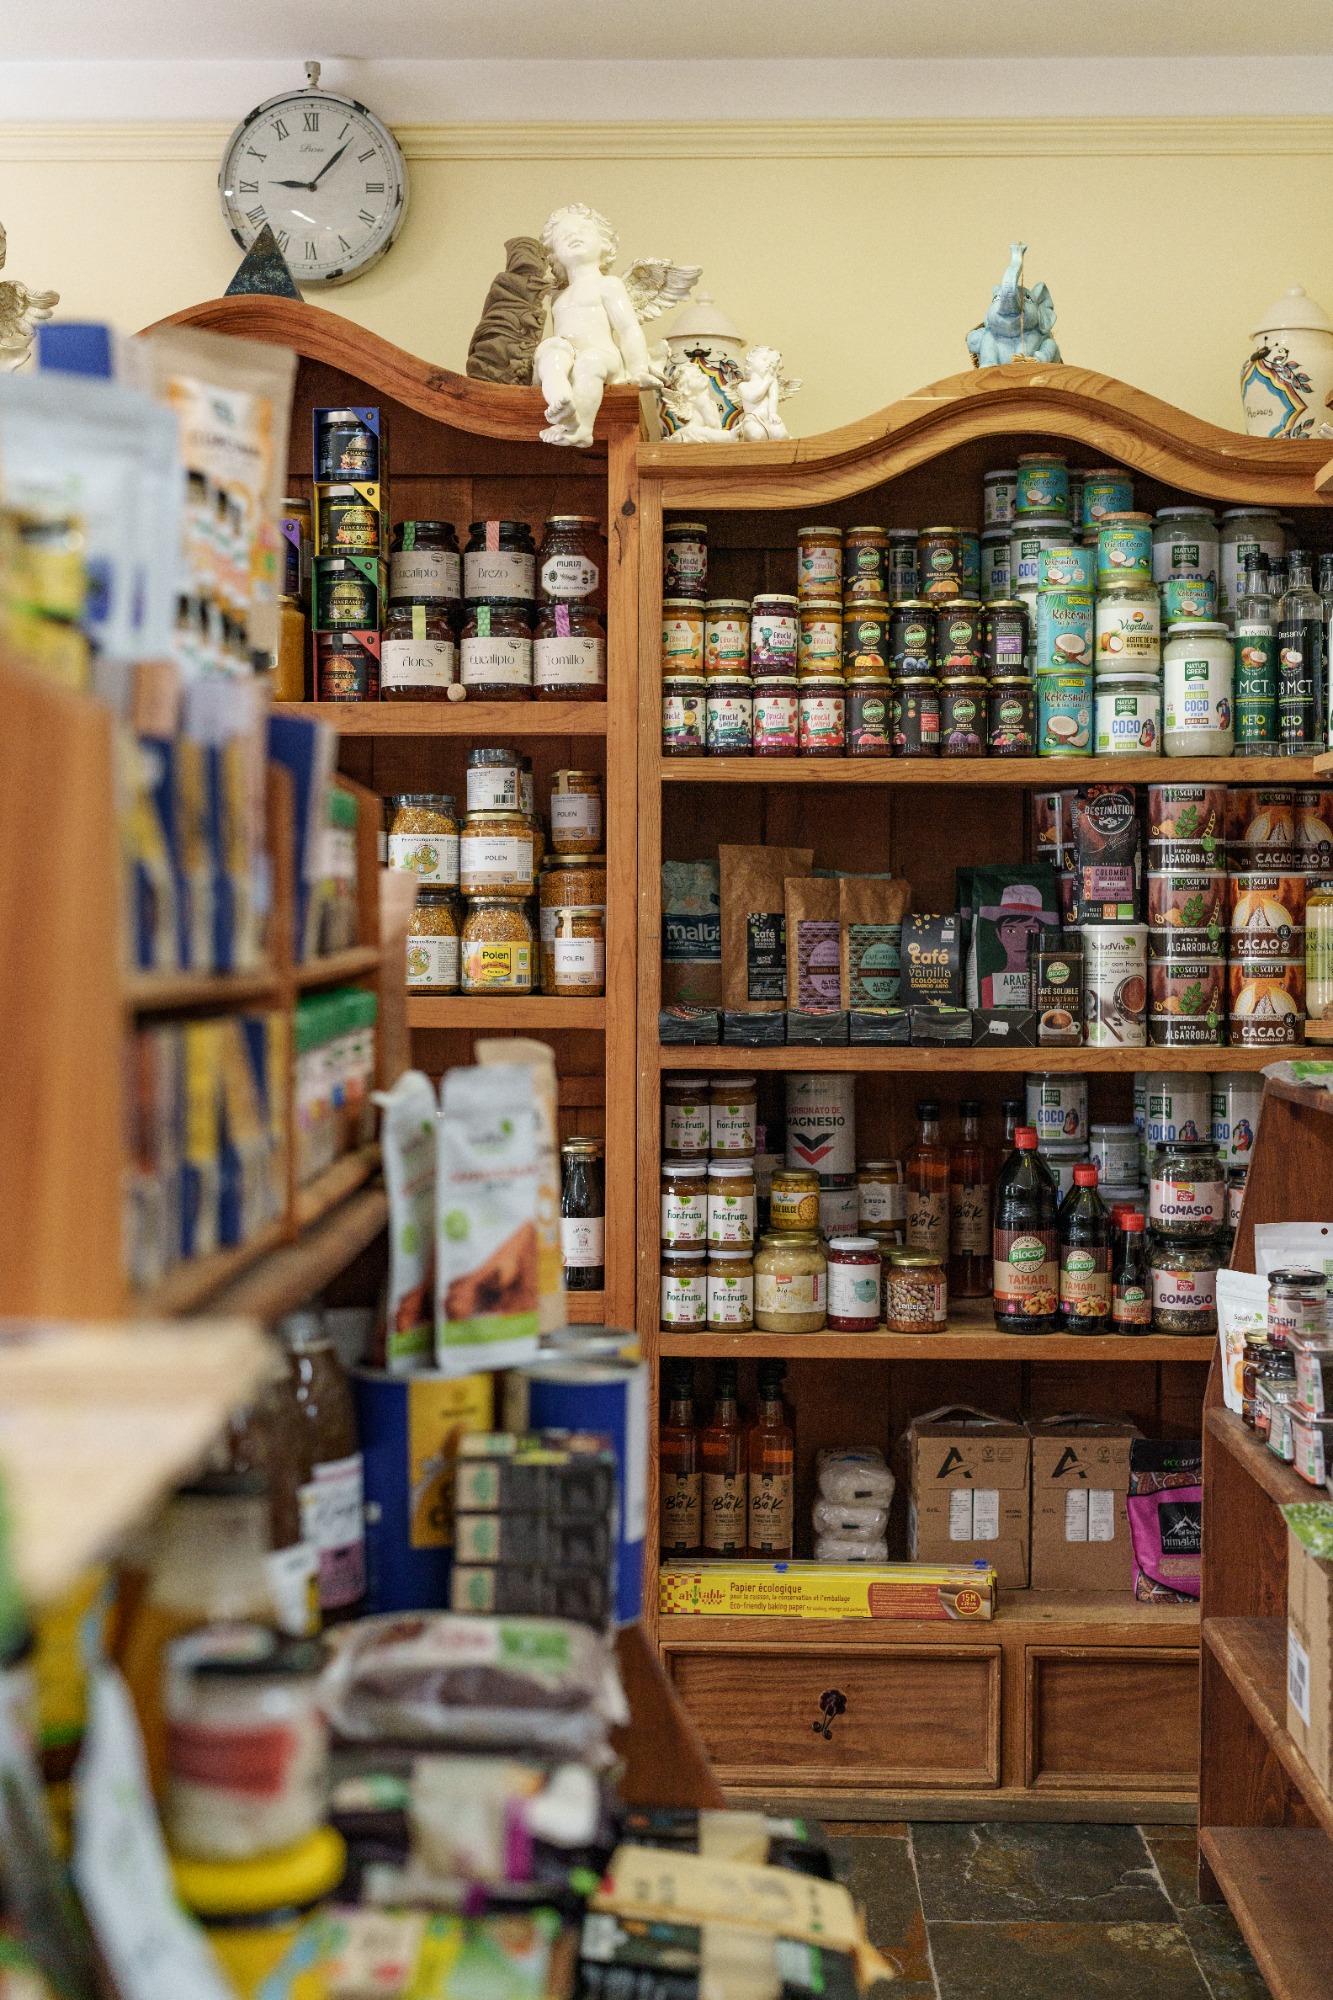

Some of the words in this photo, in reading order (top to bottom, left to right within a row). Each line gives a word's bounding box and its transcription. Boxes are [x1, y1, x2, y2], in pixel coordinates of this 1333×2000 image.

[303, 112, 320, 132] XII
[365, 182, 384, 194] III
[1174, 553, 1197, 561] GREEN
[1018, 562, 1038, 577] COC
[1118, 618, 1154, 632] Vegetalia
[1239, 680, 1269, 694] MCT
[1286, 679, 1314, 694] MCT
[1184, 700, 1209, 712] COCO
[1242, 714, 1266, 726] KETO
[1281, 714, 1303, 727] KETO
[1111, 719, 1141, 734] COCO
[1084, 803, 1135, 817] DESTINATION
[1161, 853, 1206, 864] ALGARROBA
[1095, 868, 1130, 877] COLOMBIE
[754, 928, 776, 939] café
[1091, 941, 1131, 951] SaludViva
[1166, 942, 1211, 952] ALGARROBA
[1237, 939, 1280, 950] CACAO
[482, 951, 509, 960] Polen
[911, 948, 949, 965] café
[908, 967, 952, 979] vainilla
[911, 976, 949, 985] ECOLÓGICO
[1165, 1029, 1210, 1040] ALGARROBA
[1241, 1026, 1286, 1038] CACAO
[1037, 1109, 1064, 1124] COCO
[1147, 1123, 1176, 1141] COCO
[1159, 1203, 1213, 1216] GOMASIO
[1011, 1248, 1044, 1261] Biocop
[1066, 1260, 1096, 1270] Biocop
[1008, 1273, 1049, 1286] TAMARI
[1064, 1281, 1096, 1291] TAMARI
[1126, 1293, 1145, 1301] Biocop
[1159, 1292, 1213, 1306] GOMASIO
[730, 1581, 757, 1594] Papier
[758, 1582, 802, 1595] écologique
[730, 1594, 743, 1602] pour
[730, 1601, 767, 1612] Eco-friendly
[767, 1602, 788, 1613] baking
[788, 1604, 806, 1614] paper
